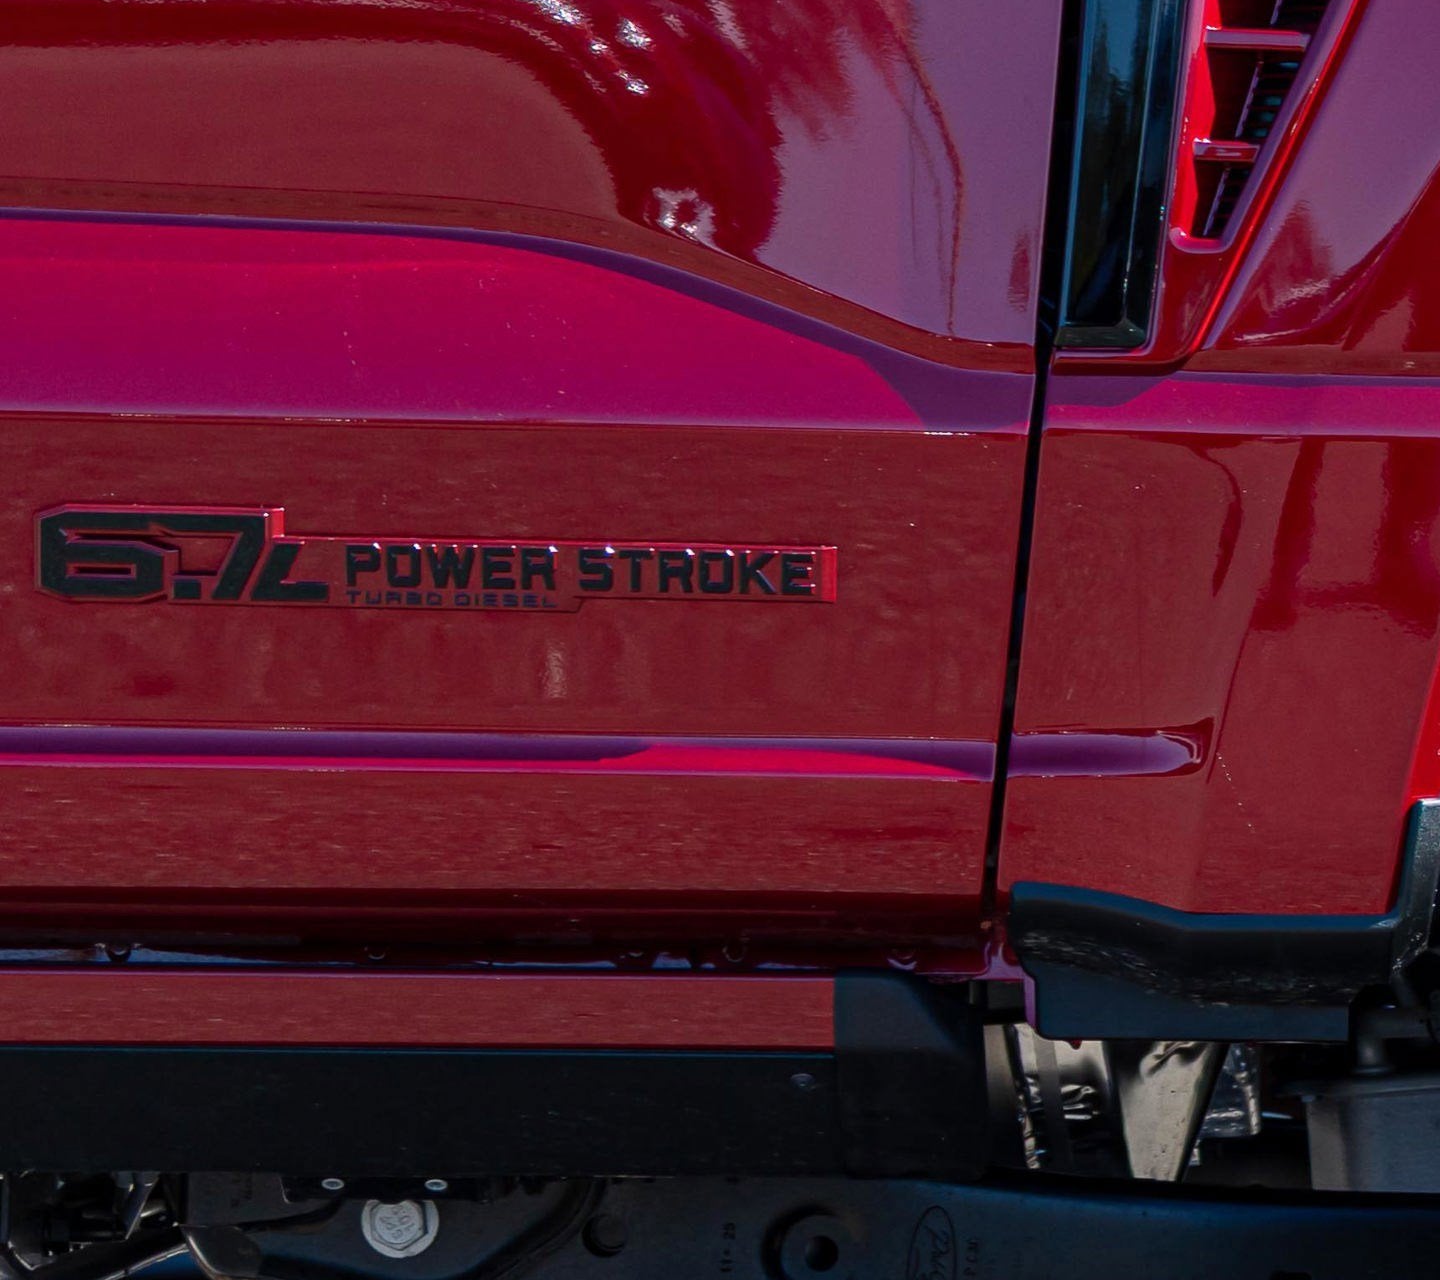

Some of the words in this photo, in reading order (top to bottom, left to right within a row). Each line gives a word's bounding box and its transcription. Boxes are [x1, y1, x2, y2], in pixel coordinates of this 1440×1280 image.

[37, 504, 330, 603] 6.7L
[345, 543, 559, 590] POWER
[578, 545, 817, 596] STROKE
[346, 589, 443, 607] TURBO
[454, 592, 558, 609] DIESEL
